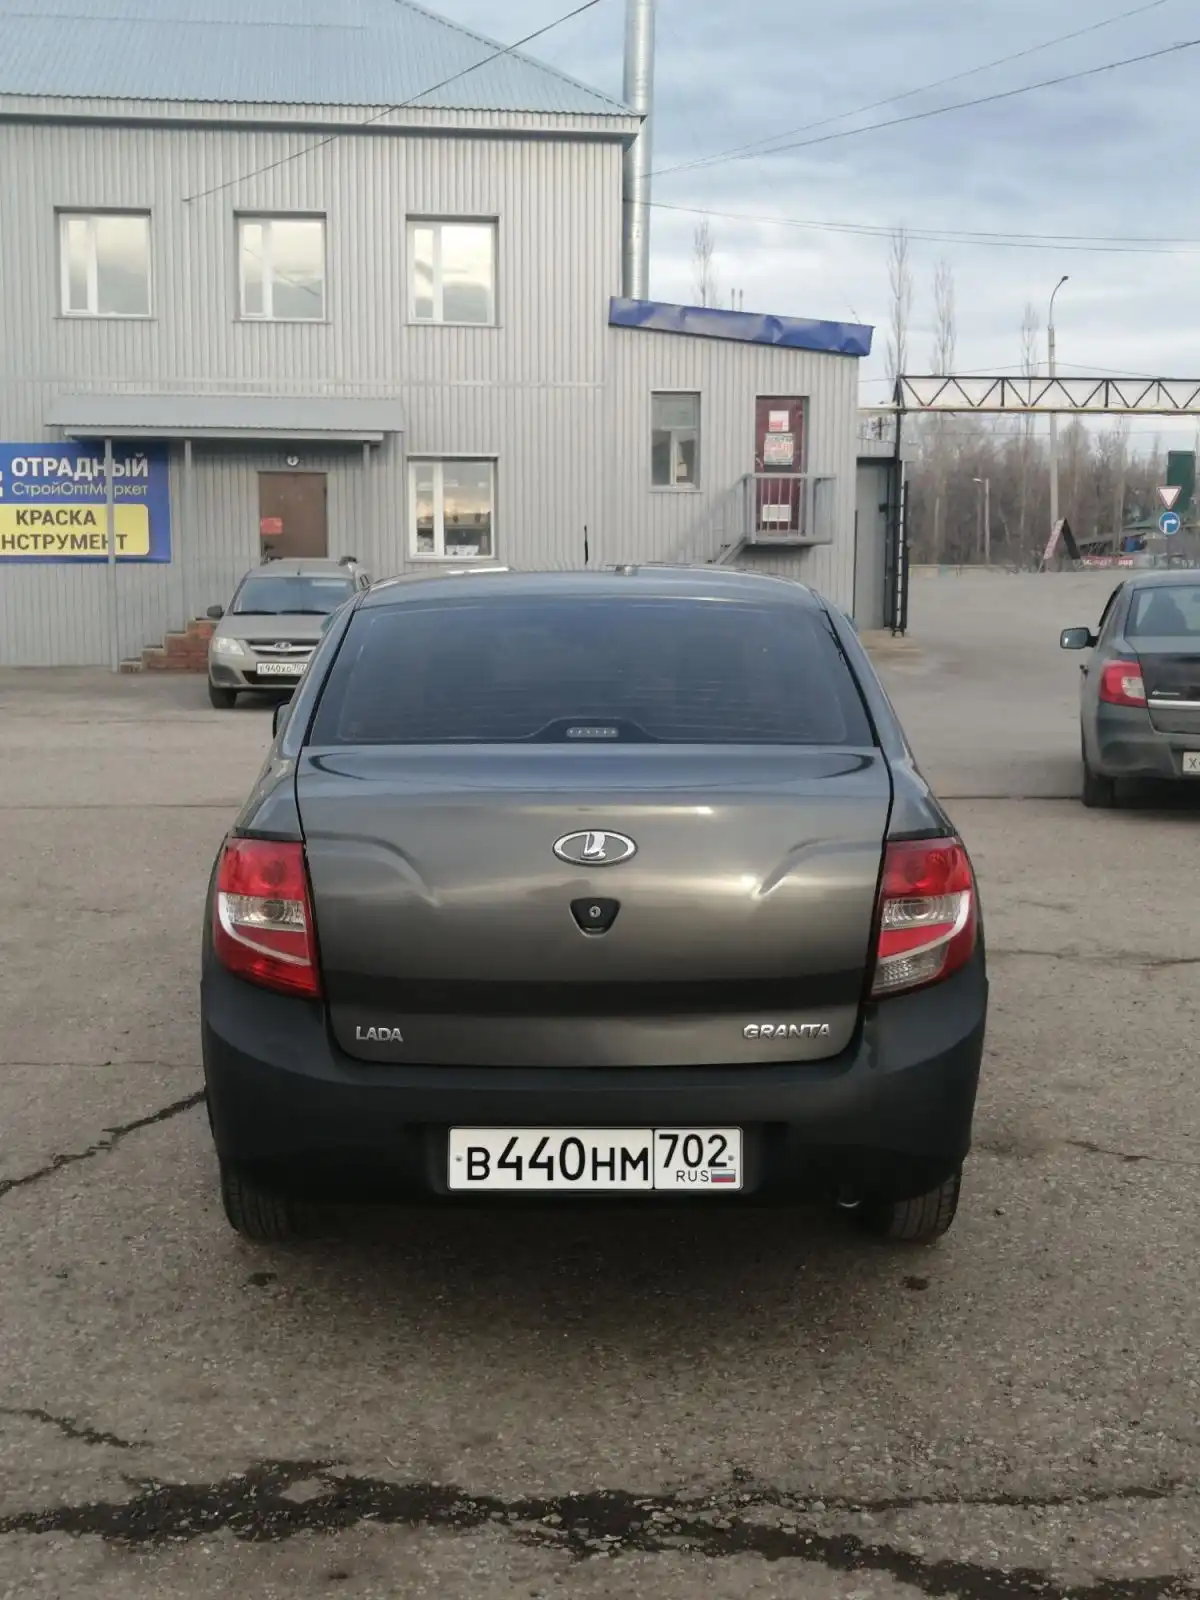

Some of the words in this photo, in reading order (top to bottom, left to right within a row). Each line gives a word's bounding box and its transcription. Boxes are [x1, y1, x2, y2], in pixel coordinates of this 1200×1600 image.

[11, 453, 148, 481] ОТРАДНЫЙ
[16, 509, 97, 526] КРАСКА
[356, 1025, 404, 1042] LADA
[743, 1023, 831, 1039] GRANTA
[466, 1136, 649, 1181] В440НМ
[659, 1134, 728, 1168] 702
[676, 1170, 710, 1182] RUS
